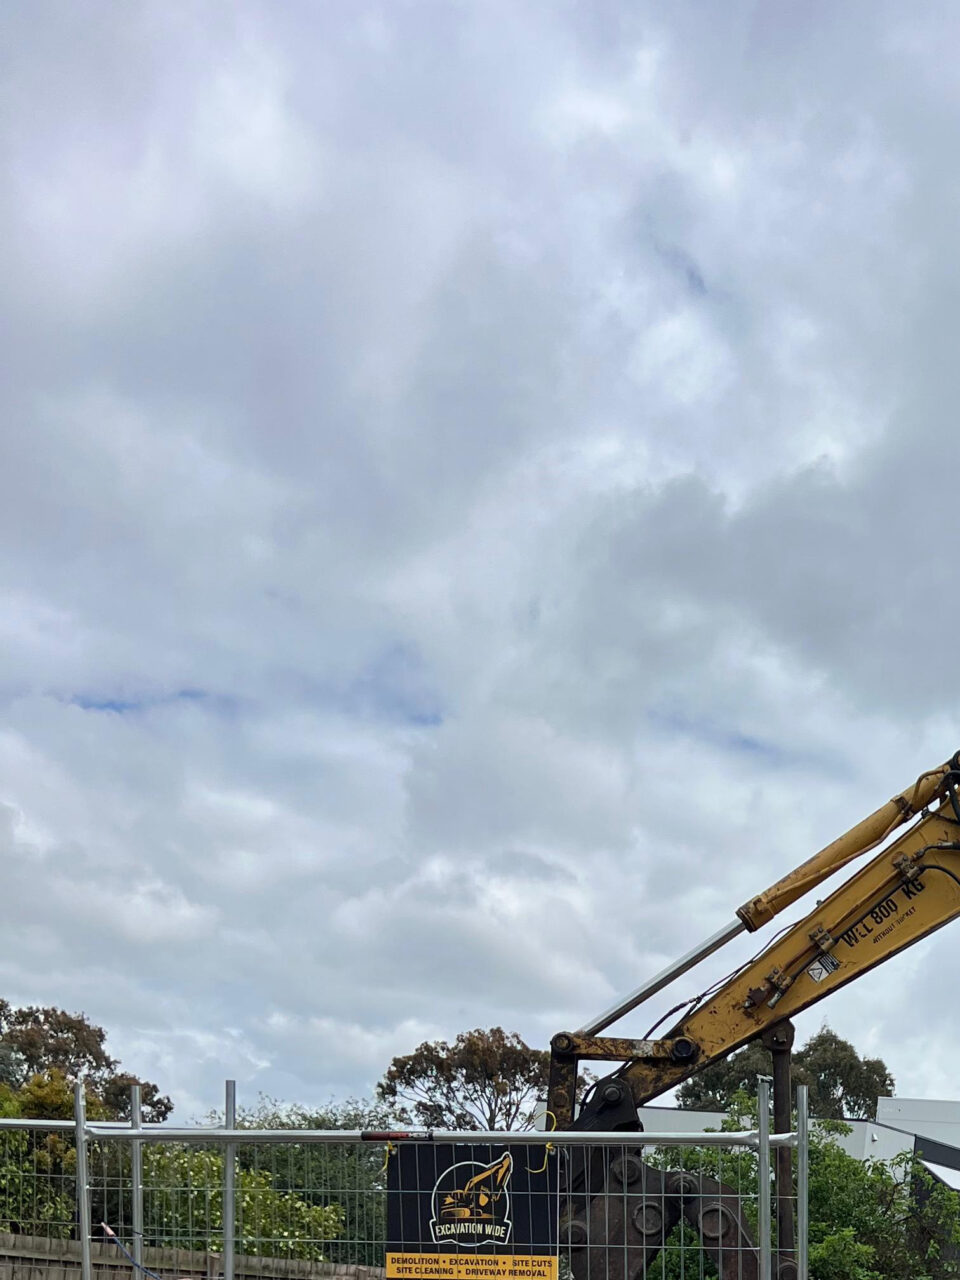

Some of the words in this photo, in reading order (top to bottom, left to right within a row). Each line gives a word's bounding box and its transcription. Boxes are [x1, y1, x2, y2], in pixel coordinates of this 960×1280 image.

[871, 898, 898, 924] 800
[901, 879, 925, 900] KG
[435, 1223, 483, 1236] EXCAVATION
[485, 1224, 507, 1237] WIDE
[391, 1257, 439, 1265] DEMOLITION
[449, 1258, 499, 1266] EXCAVATION
[414, 1267, 454, 1275] CLEANING
[465, 1268, 507, 1276] DRIVEWAY
[508, 1269, 547, 1277] REMOVAL
